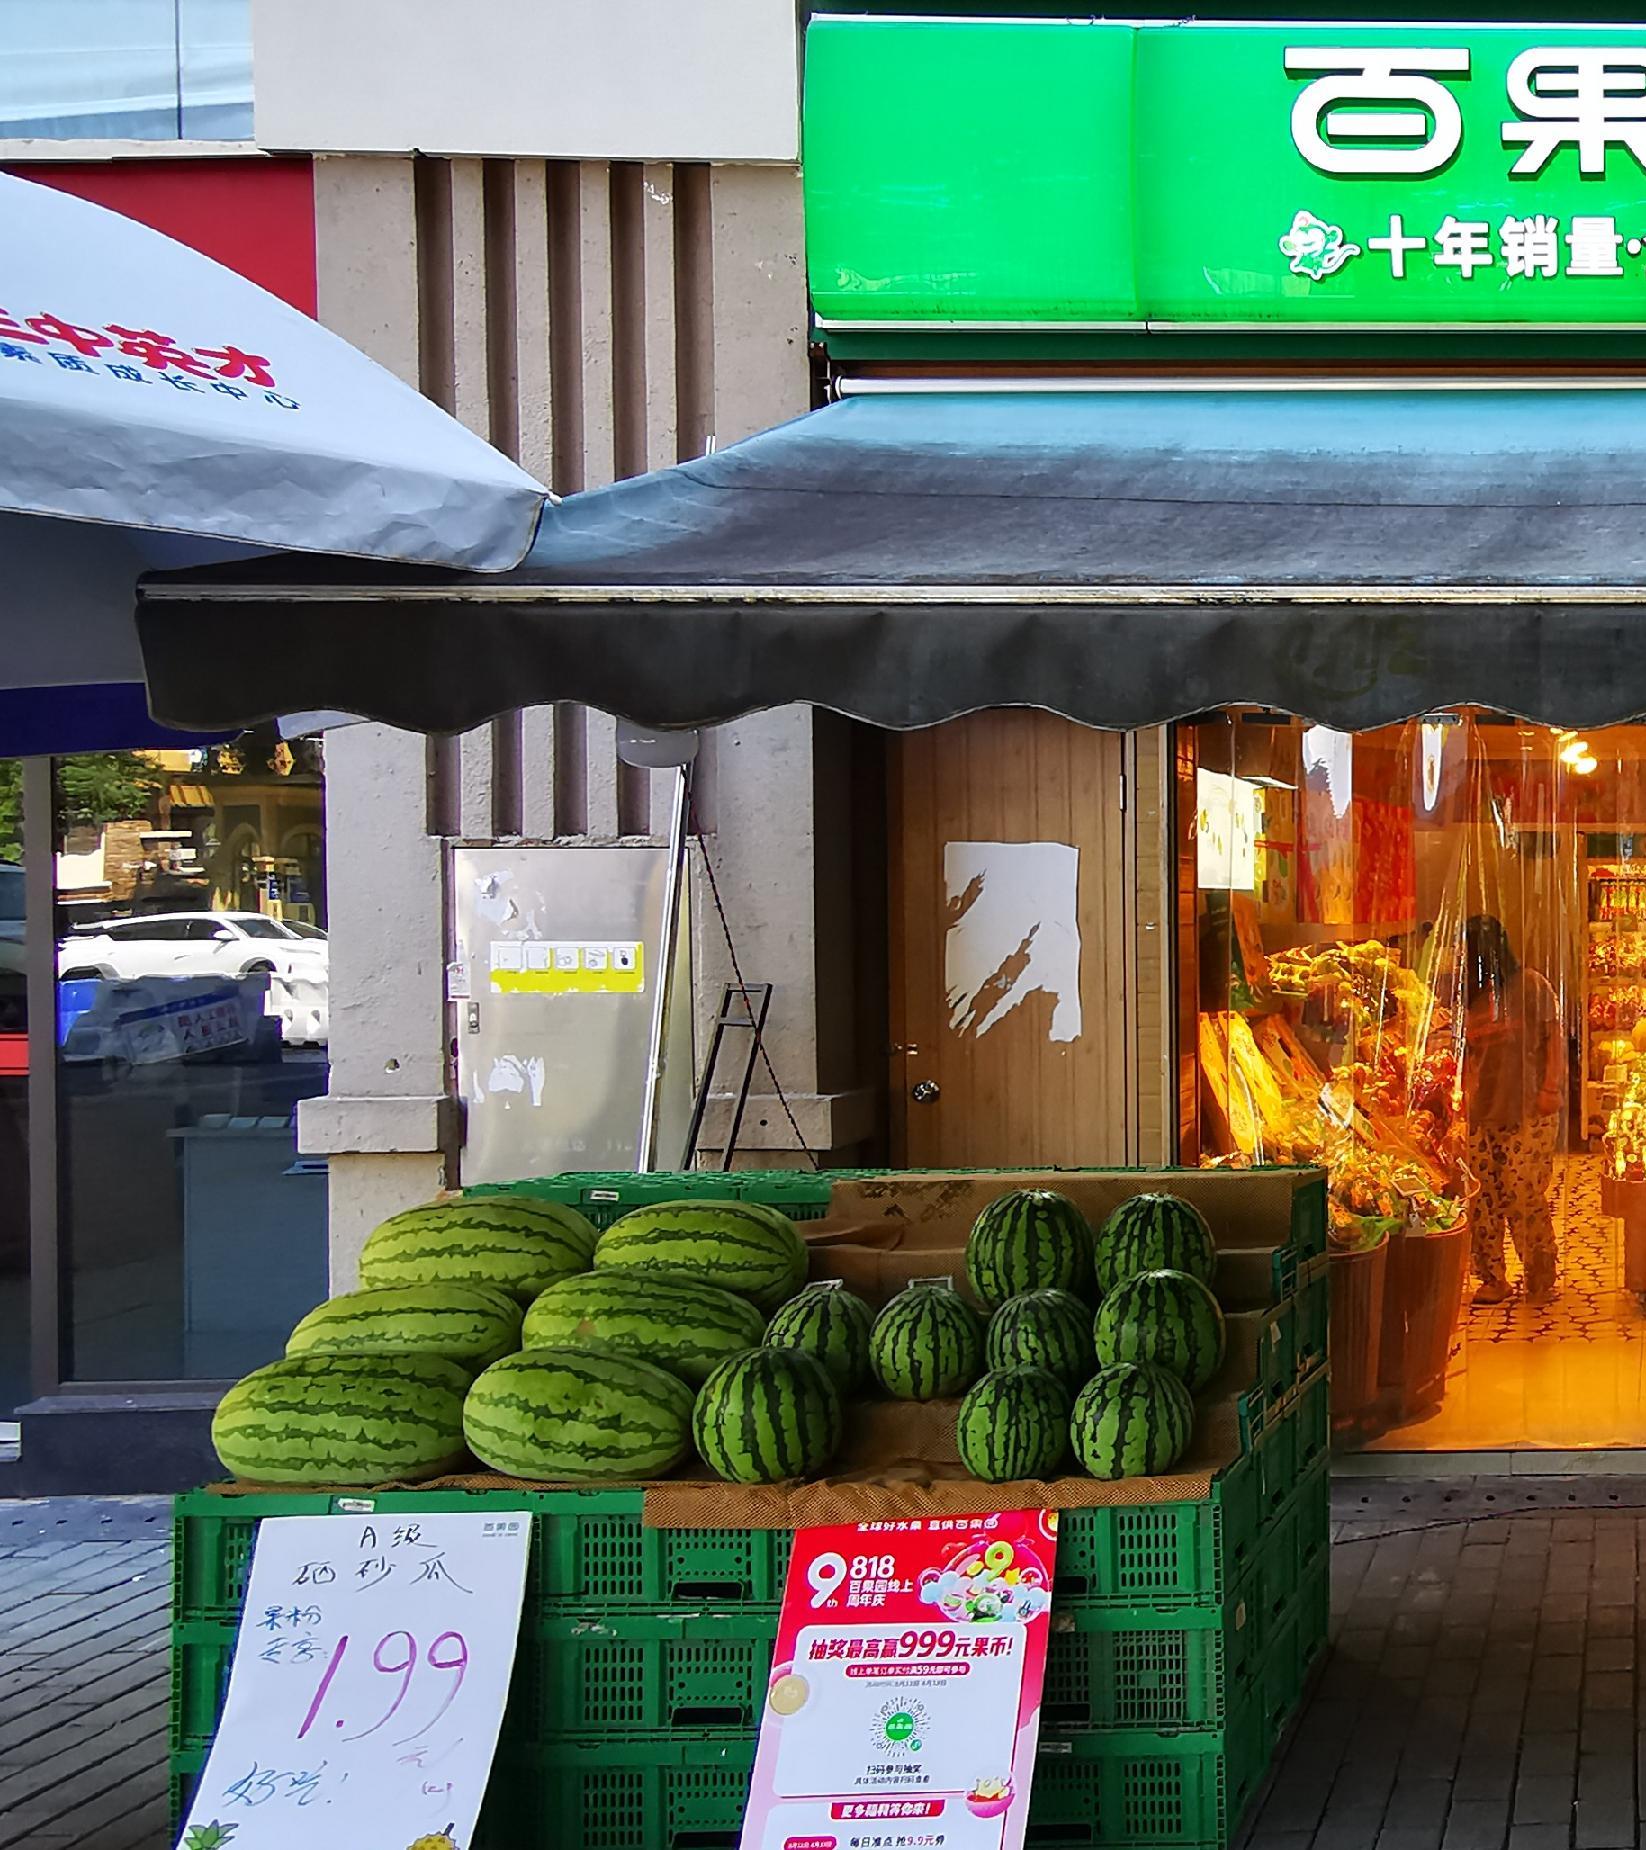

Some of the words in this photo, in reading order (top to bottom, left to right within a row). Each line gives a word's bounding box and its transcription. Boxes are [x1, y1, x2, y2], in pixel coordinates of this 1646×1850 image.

[291, 1551, 473, 1594] 硒砂瓜
[849, 1554, 896, 1579] 818
[297, 1631, 468, 1748] 1.99
